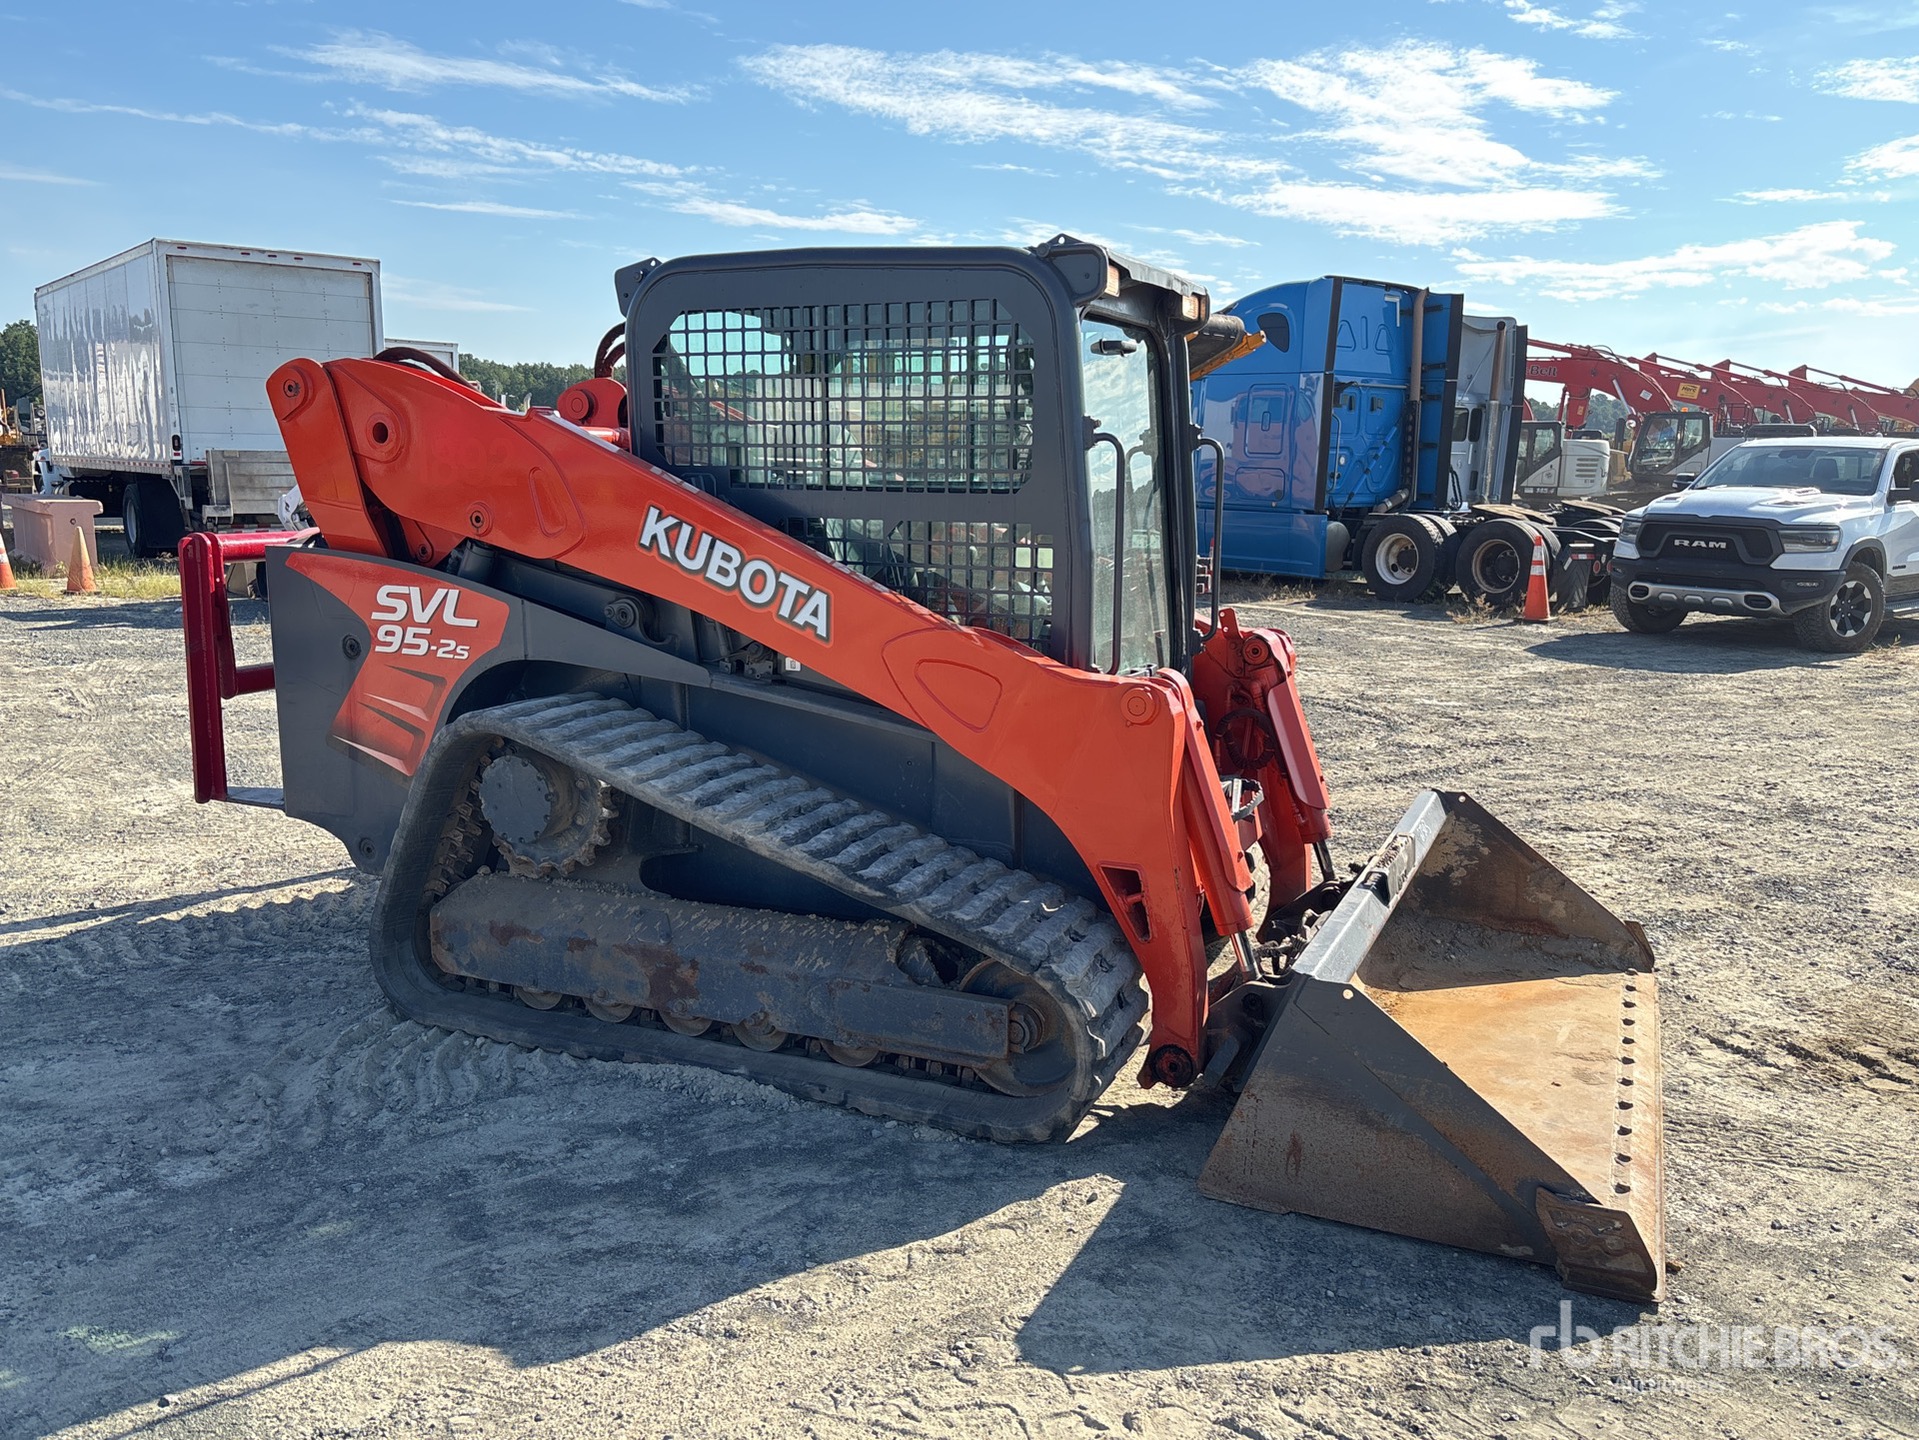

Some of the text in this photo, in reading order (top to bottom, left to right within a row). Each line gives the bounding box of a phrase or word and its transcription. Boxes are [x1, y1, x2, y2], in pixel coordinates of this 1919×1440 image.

[1527, 365, 1557, 376] Belt
[1674, 539, 1727, 549] RAM
[639, 505, 829, 639] KUBOTA
[371, 585, 479, 628] SVL
